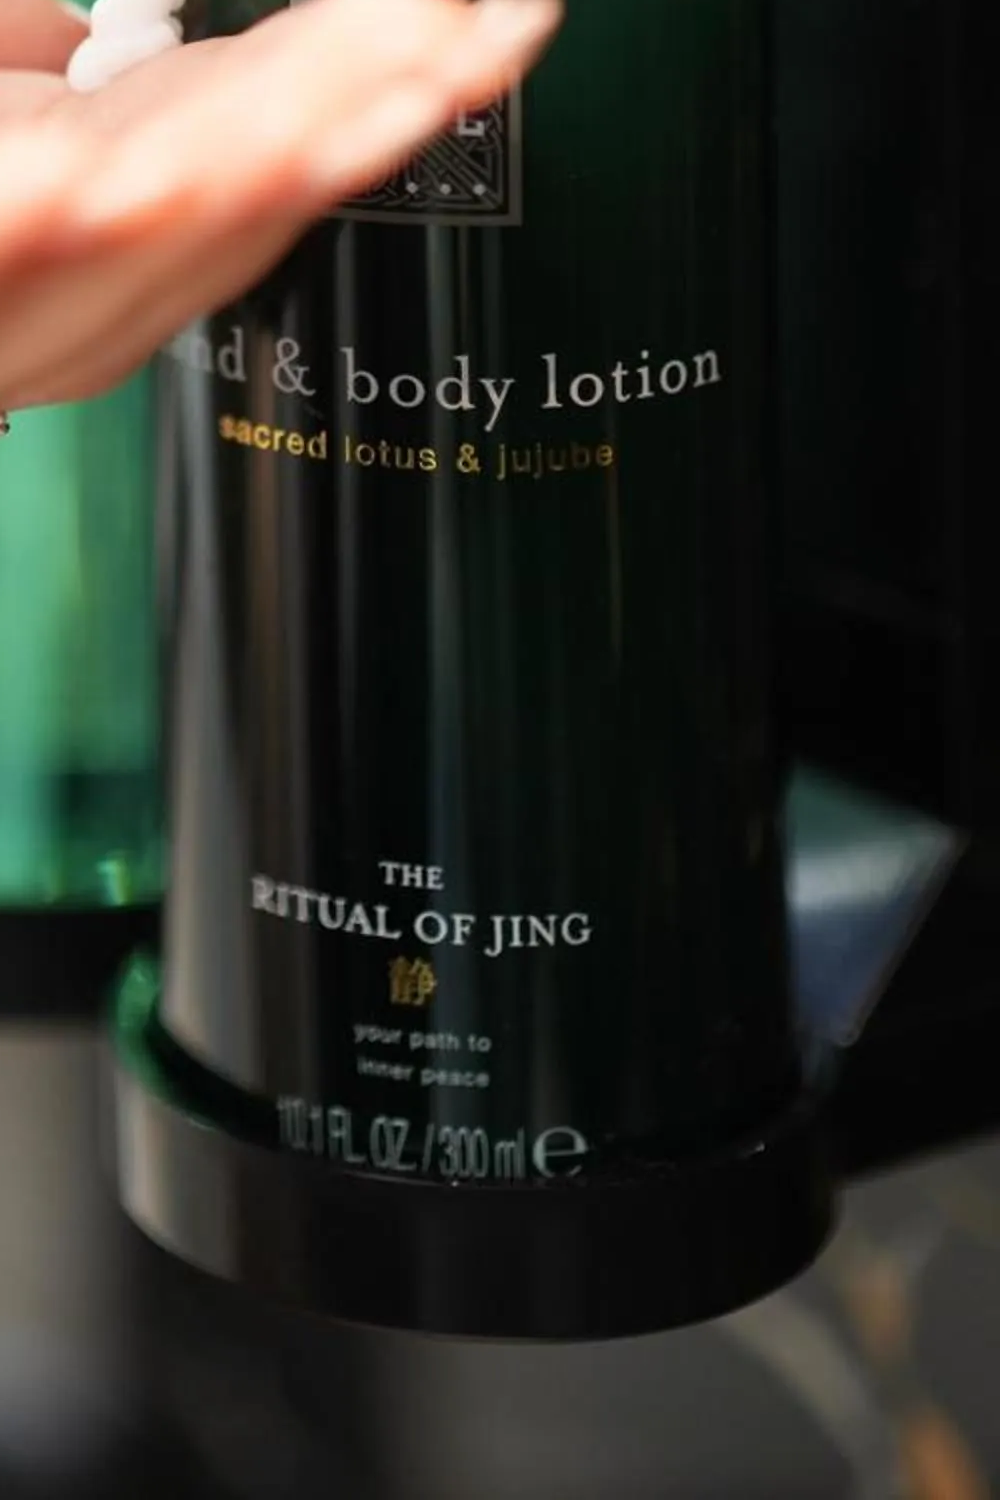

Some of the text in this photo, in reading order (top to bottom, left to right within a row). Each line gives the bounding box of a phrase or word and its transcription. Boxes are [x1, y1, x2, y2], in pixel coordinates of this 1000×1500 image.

[272, 337, 316, 396] &
[341, 346, 515, 432] body
[540, 348, 722, 409] lotion
[218, 414, 614, 482] sacred lotus & jujube
[378, 860, 444, 890] THE
[251, 874, 593, 957] RITUAL OF JING
[353, 1023, 493, 1052] your path to
[356, 1055, 491, 1088] inner peace
[437, 1125, 491, 1180] 300
[493, 1125, 527, 1180] ml
